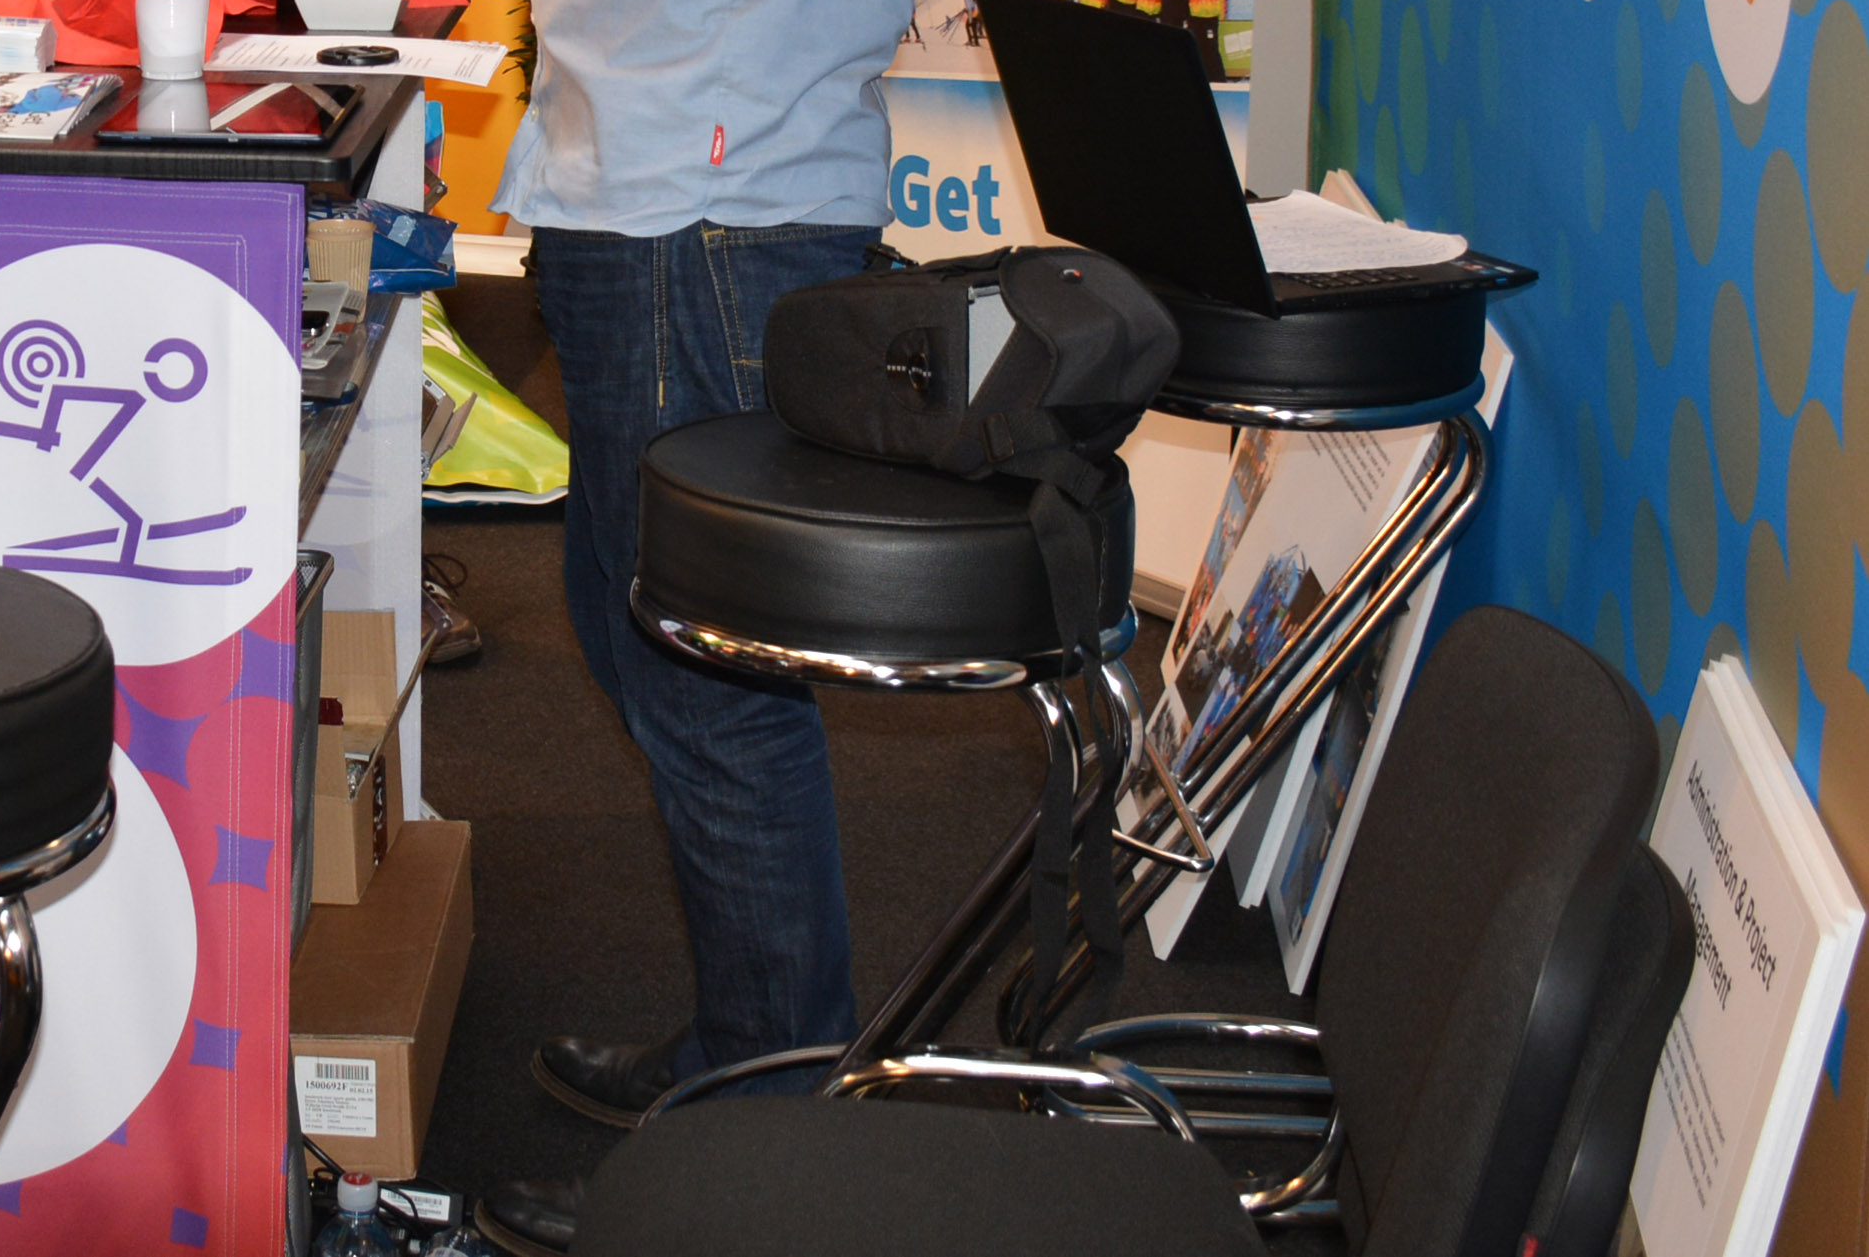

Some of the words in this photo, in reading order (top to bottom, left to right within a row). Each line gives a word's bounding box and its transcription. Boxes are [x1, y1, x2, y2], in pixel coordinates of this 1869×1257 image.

[889, 154, 1002, 236] Get
[1686, 759, 1738, 901] Administration
[1734, 878, 1748, 920] &
[1741, 895, 1777, 992] Project
